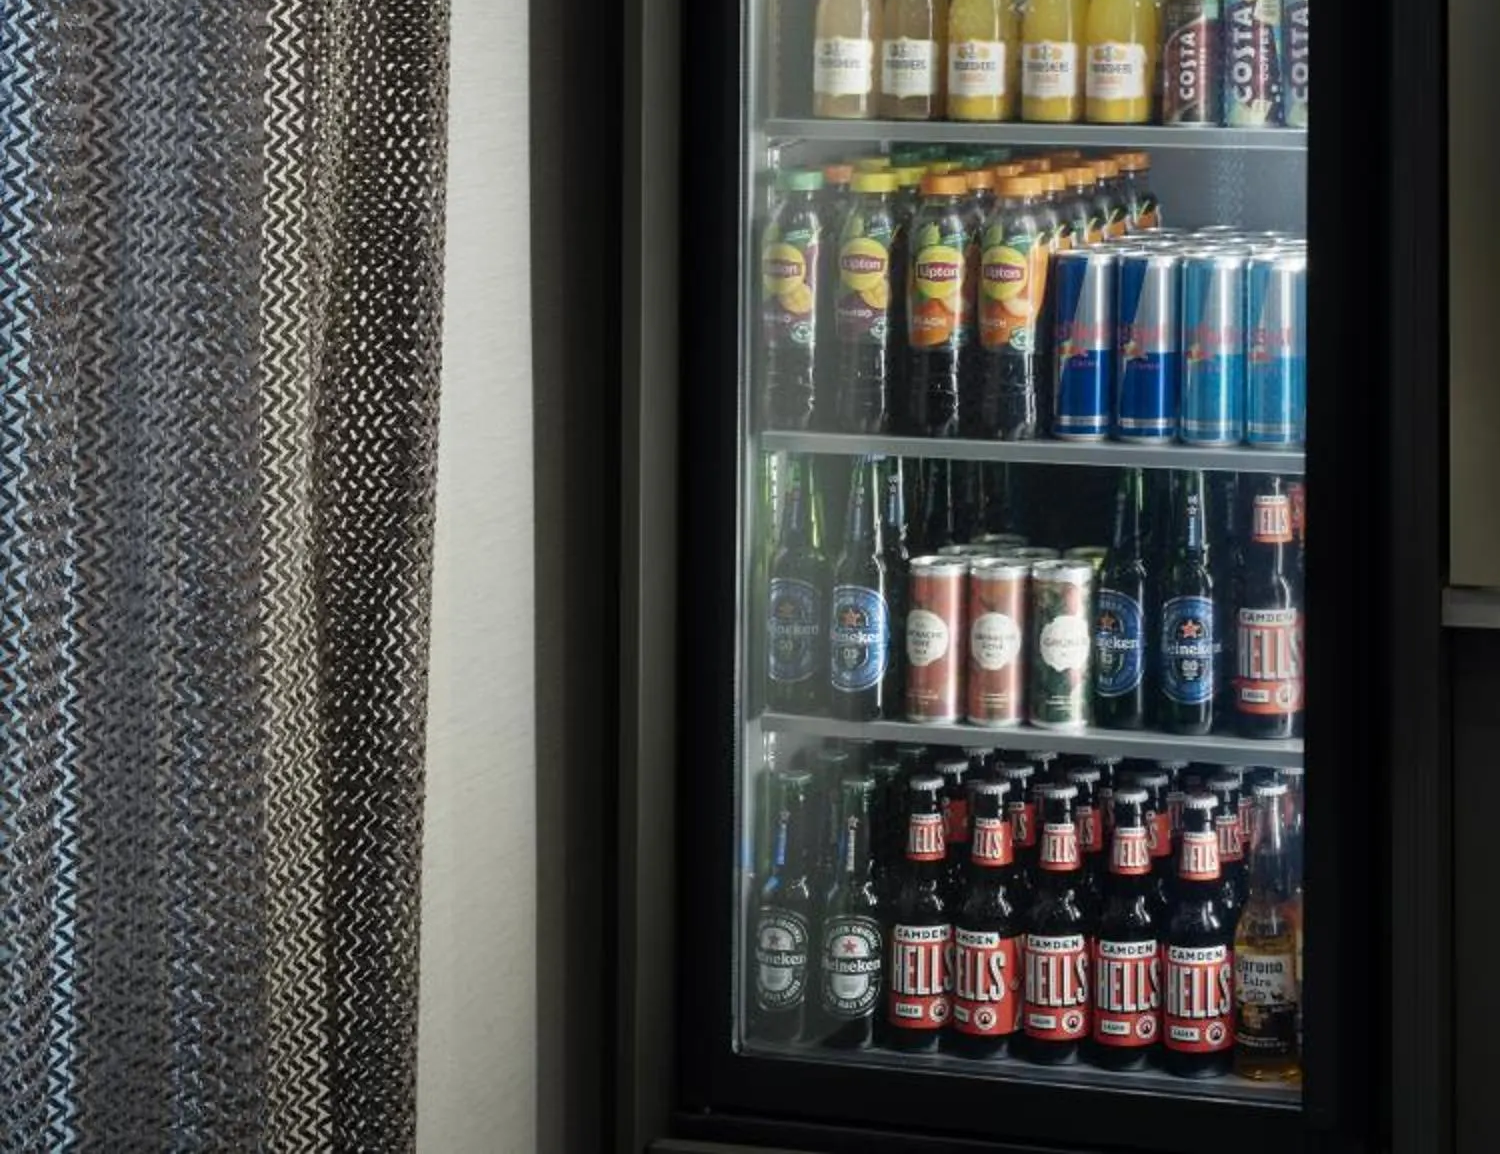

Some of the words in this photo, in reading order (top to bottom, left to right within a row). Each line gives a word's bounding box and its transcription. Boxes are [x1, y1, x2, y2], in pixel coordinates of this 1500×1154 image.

[1180, 31, 1197, 100] COSTA
[1232, 5, 1254, 104] COSTA
[919, 265, 958, 279] Lipton
[897, 927, 947, 939] CAMDEN
[1030, 937, 1079, 949] CAMDEN
[1102, 943, 1153, 955] CAMDEN
[1171, 949, 1224, 961] CAMDEN
[956, 947, 1005, 1001] ELLS
[1026, 952, 1089, 1006] HELLS
[1098, 958, 1161, 1012] HELLS
[1167, 963, 1232, 1018] HELLS
